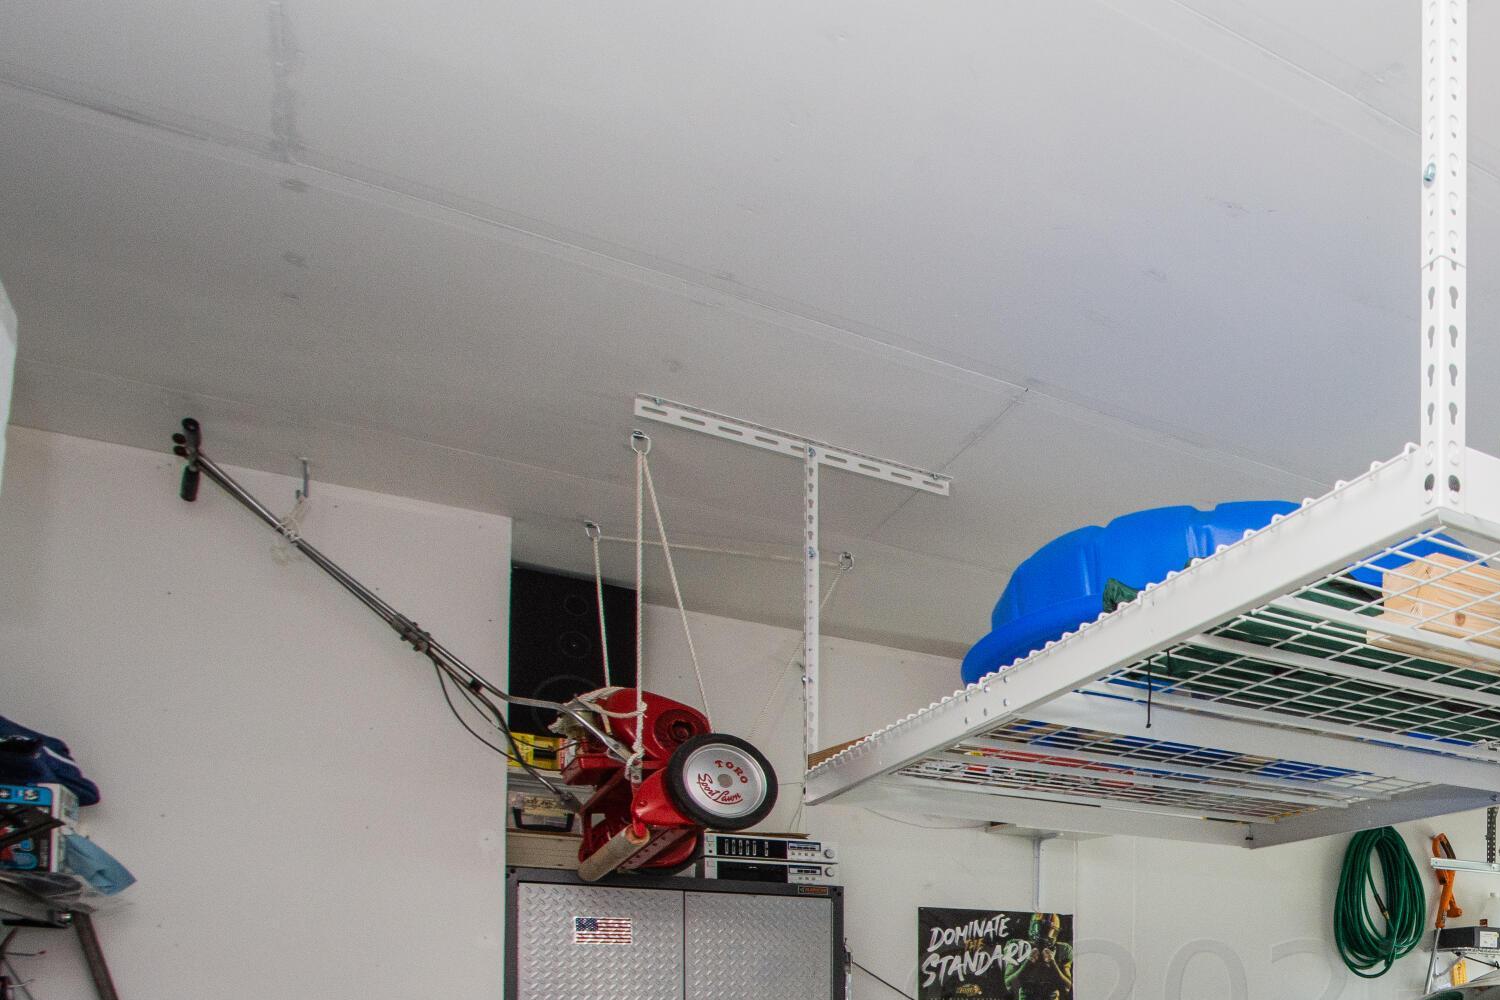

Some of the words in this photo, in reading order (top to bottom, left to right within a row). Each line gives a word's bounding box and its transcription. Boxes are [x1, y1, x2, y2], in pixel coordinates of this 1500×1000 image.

[714, 759, 748, 784] TORO
[927, 913, 1011, 952] DOMINATE
[964, 937, 985, 951] THE
[921, 940, 1032, 988] STANDARD
